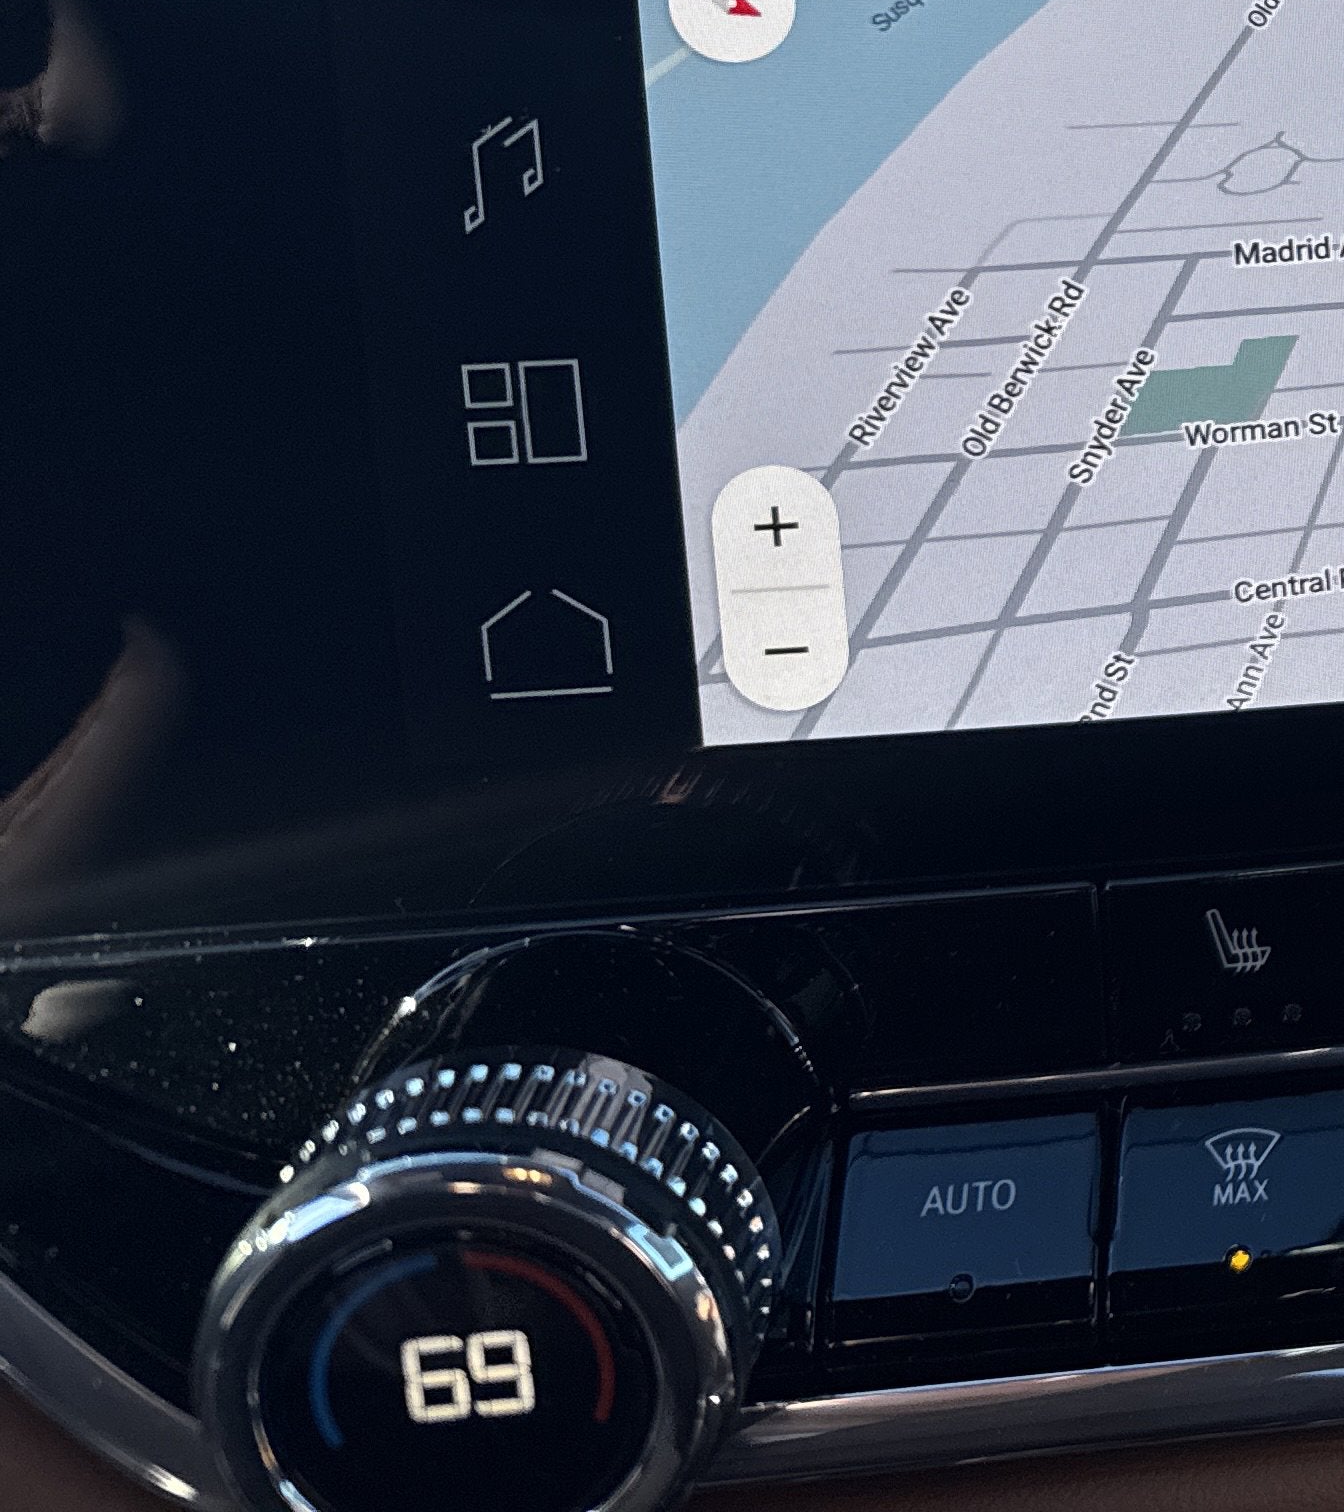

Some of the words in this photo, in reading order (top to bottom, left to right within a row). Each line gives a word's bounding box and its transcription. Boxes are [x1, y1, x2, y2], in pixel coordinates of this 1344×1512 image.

[1234, 238, 1330, 266] Madrid
[850, 335, 935, 446] Riverview
[928, 289, 971, 339] Ave
[962, 408, 1002, 458] Old
[990, 318, 1058, 415] Berwick
[1049, 280, 1085, 321] Rd
[1069, 397, 1130, 483] Snyder
[1117, 349, 1155, 399] Ave
[1184, 417, 1299, 447] Worman
[1309, 413, 1337, 434] St
[1235, 570, 1332, 602] Central
[1106, 652, 1135, 681] St
[1227, 661, 1260, 712] Ann
[1250, 613, 1285, 661] Ave
[920, 1178, 1017, 1218] AUTO
[1212, 1178, 1269, 1207] MAX
[401, 1329, 536, 1424] 69
